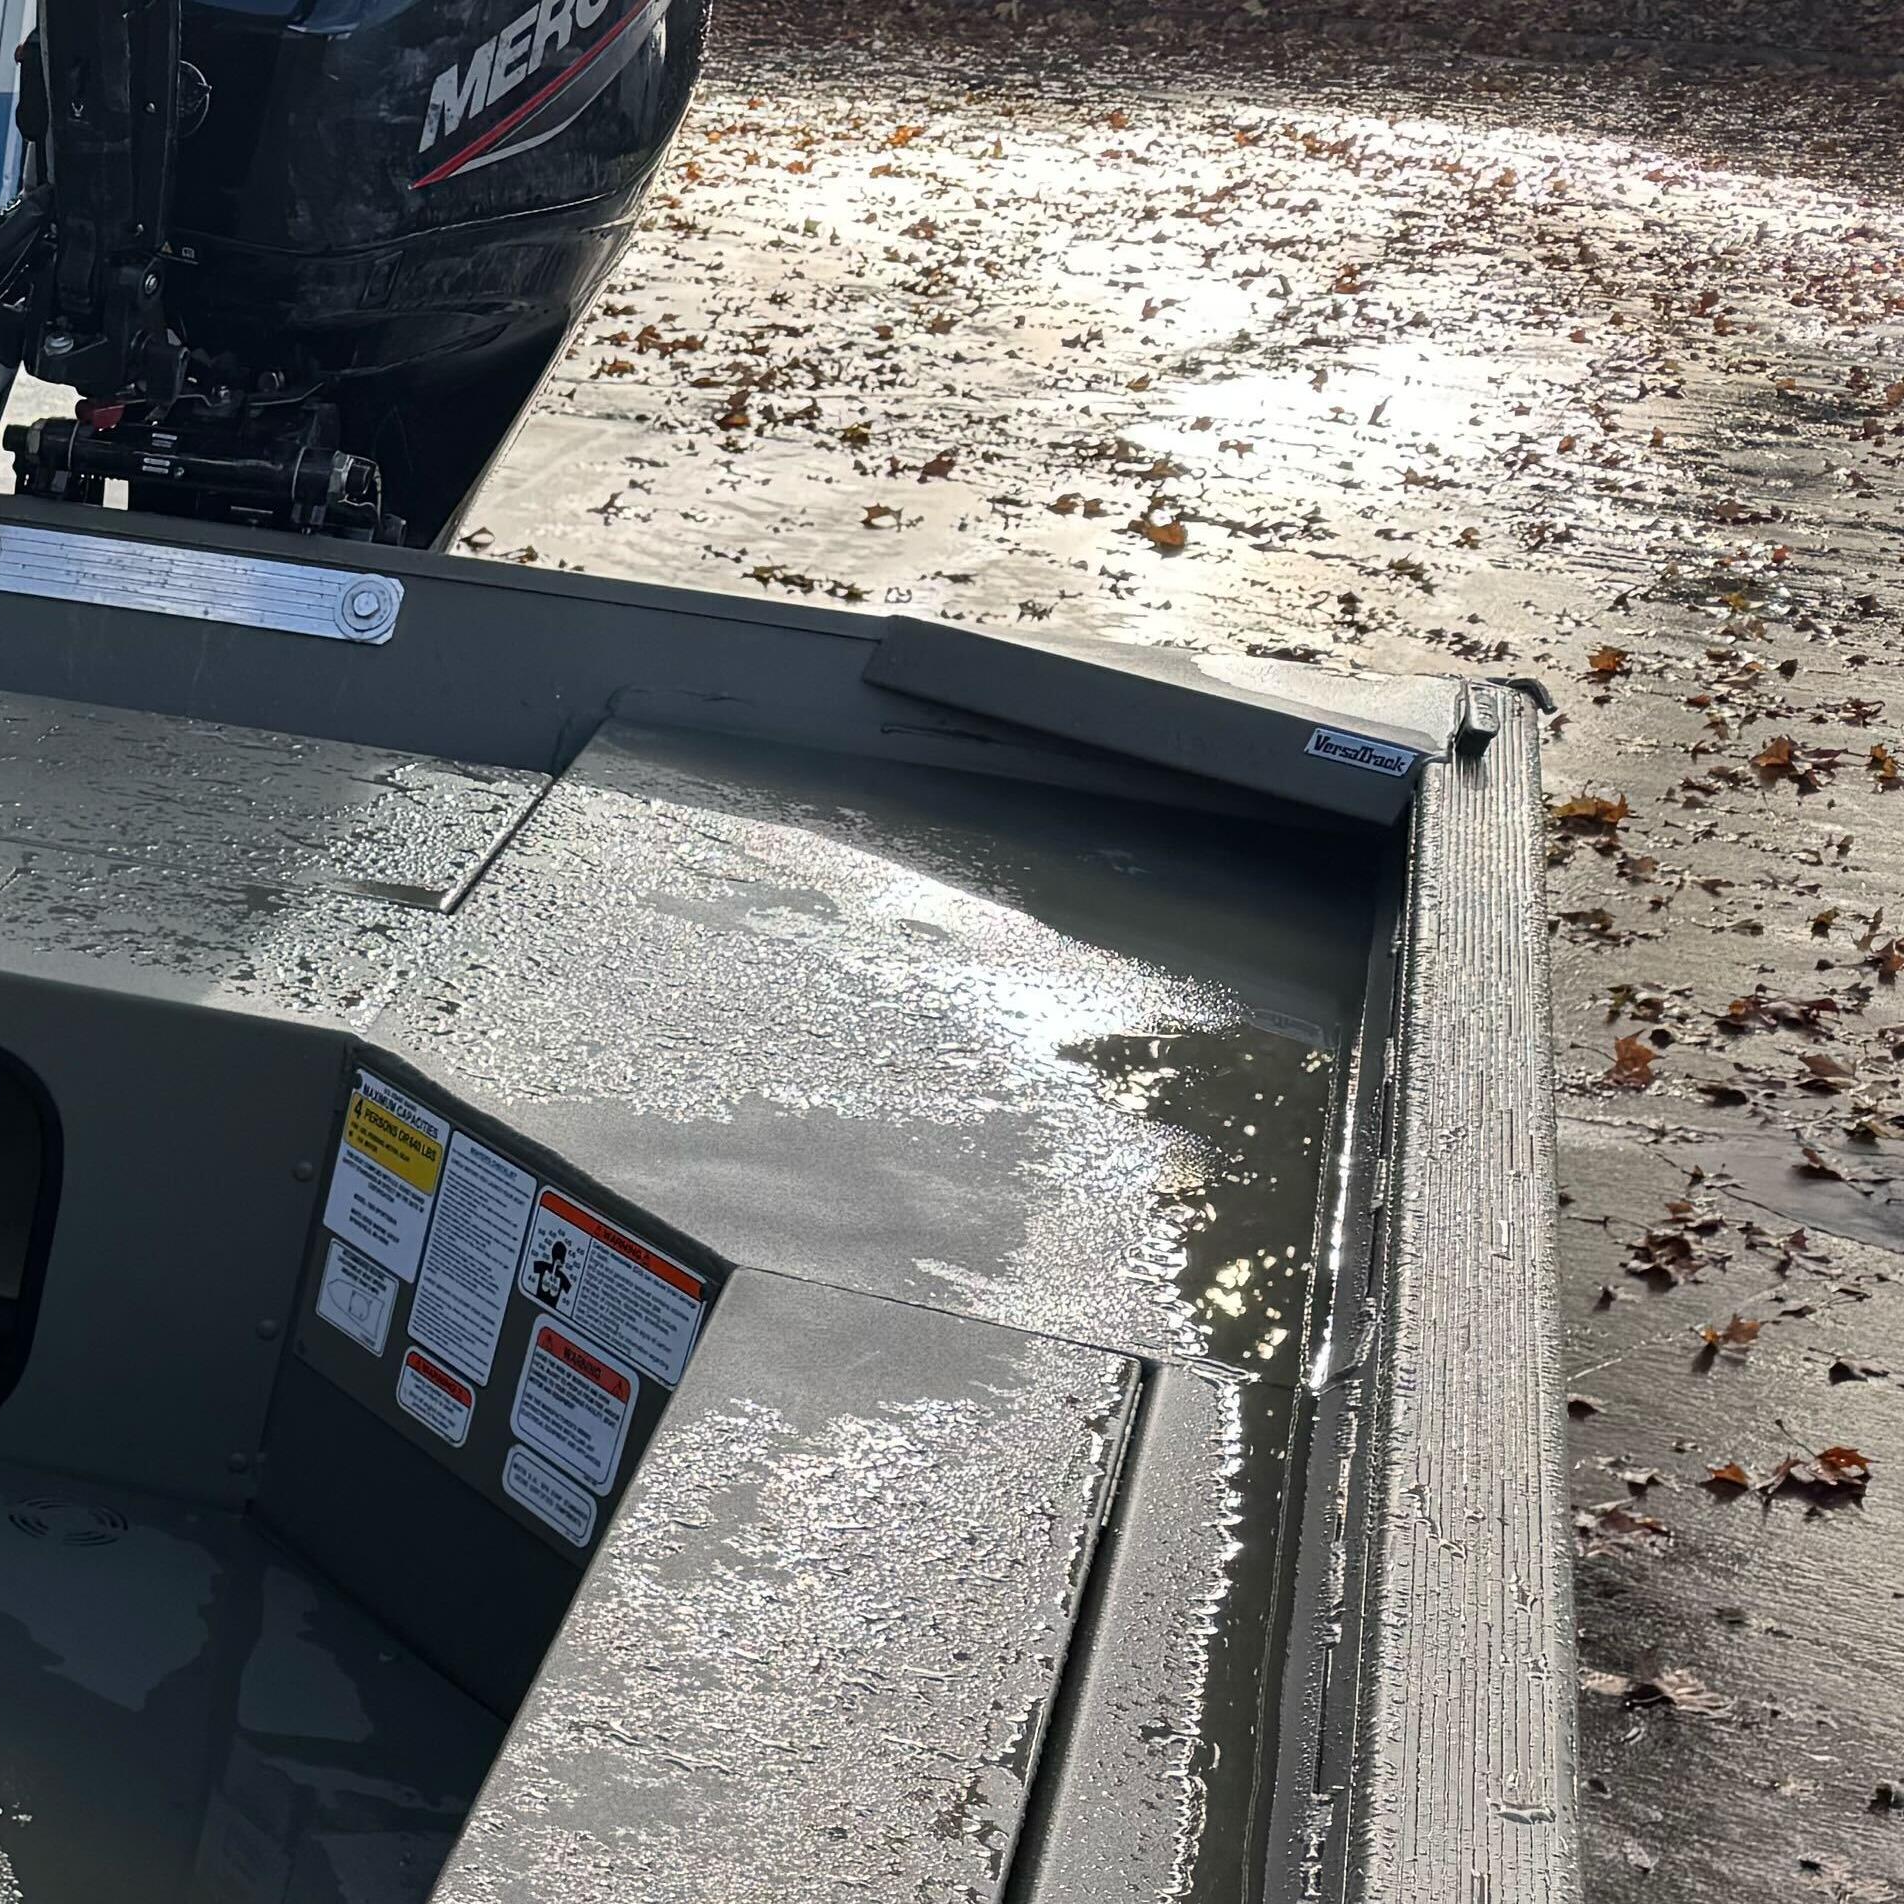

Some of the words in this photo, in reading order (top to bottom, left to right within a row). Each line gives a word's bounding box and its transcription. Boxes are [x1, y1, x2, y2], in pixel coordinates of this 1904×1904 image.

[1314, 734, 1406, 772] VersaTrack
[354, 1099, 363, 1119] 4
[365, 1108, 398, 1137] PERSONS
[363, 1083, 397, 1112] MAXIMUM
[396, 1106, 438, 1139] CAPACITIES
[603, 1229, 643, 1260] WARNING
[564, 1346, 601, 1380] WARNING
